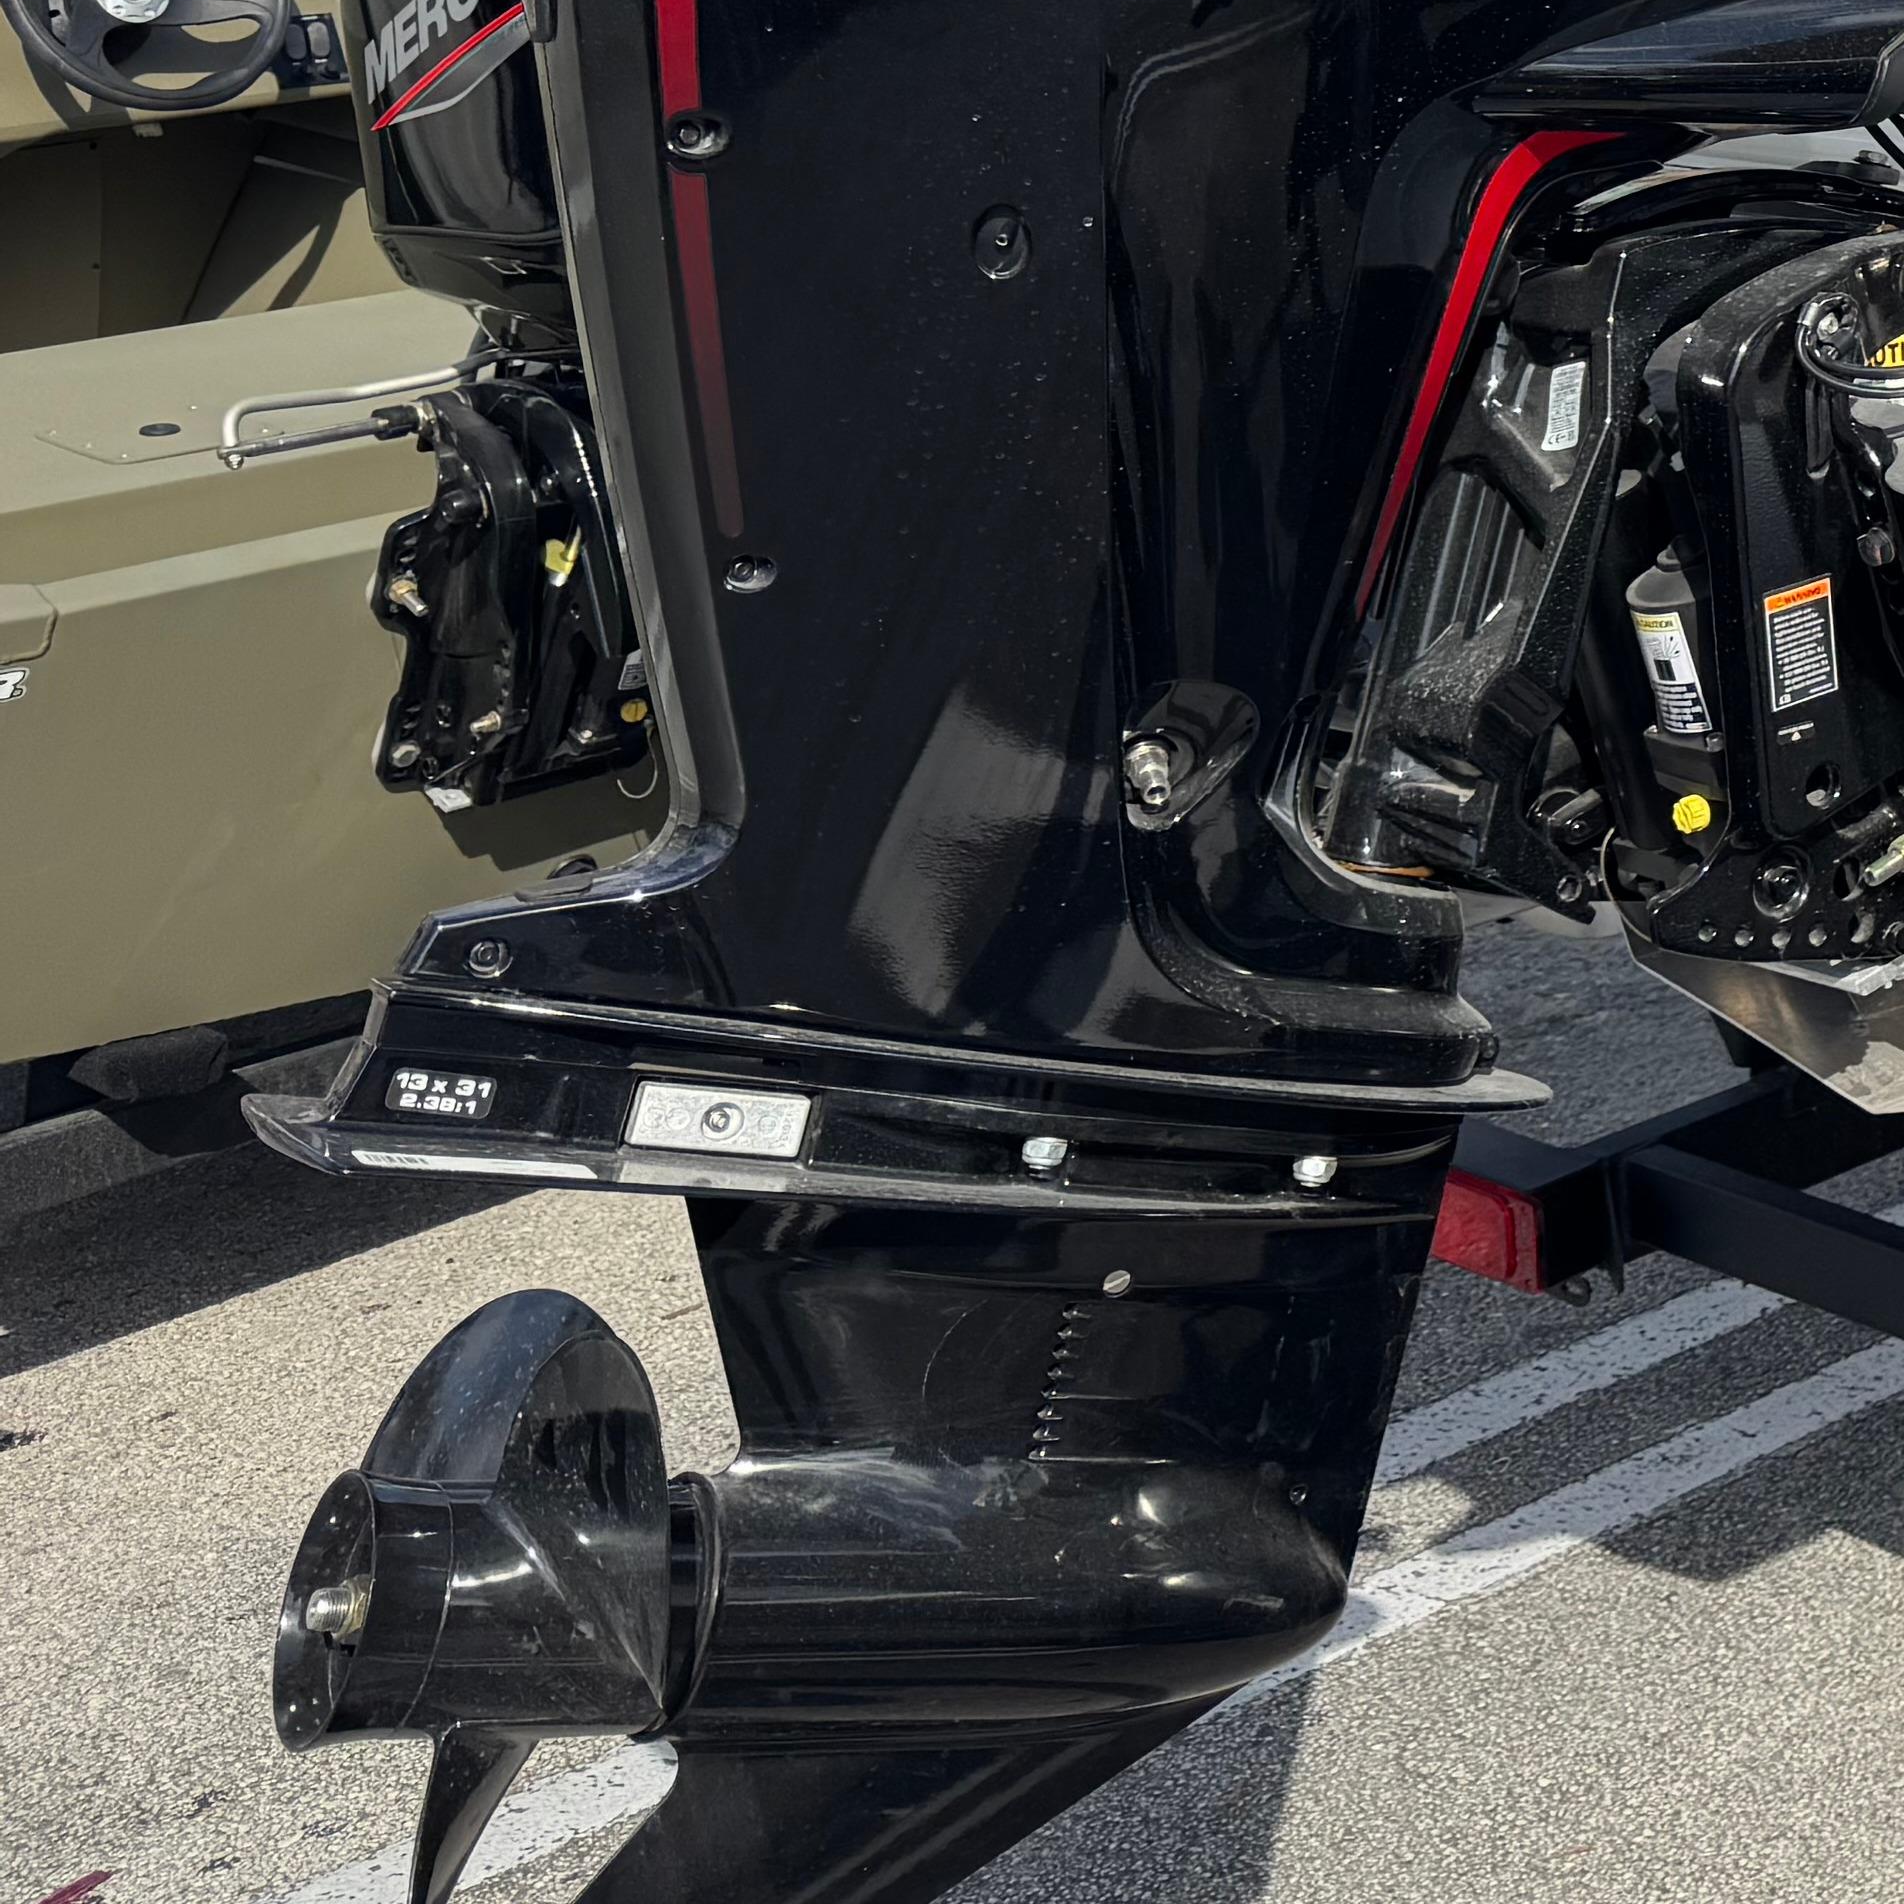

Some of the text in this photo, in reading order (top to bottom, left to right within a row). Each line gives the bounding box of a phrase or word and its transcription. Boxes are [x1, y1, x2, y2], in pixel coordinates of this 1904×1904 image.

[396, 1072, 492, 1099] 13 x 31
[399, 1092, 477, 1115] 2.38:1
